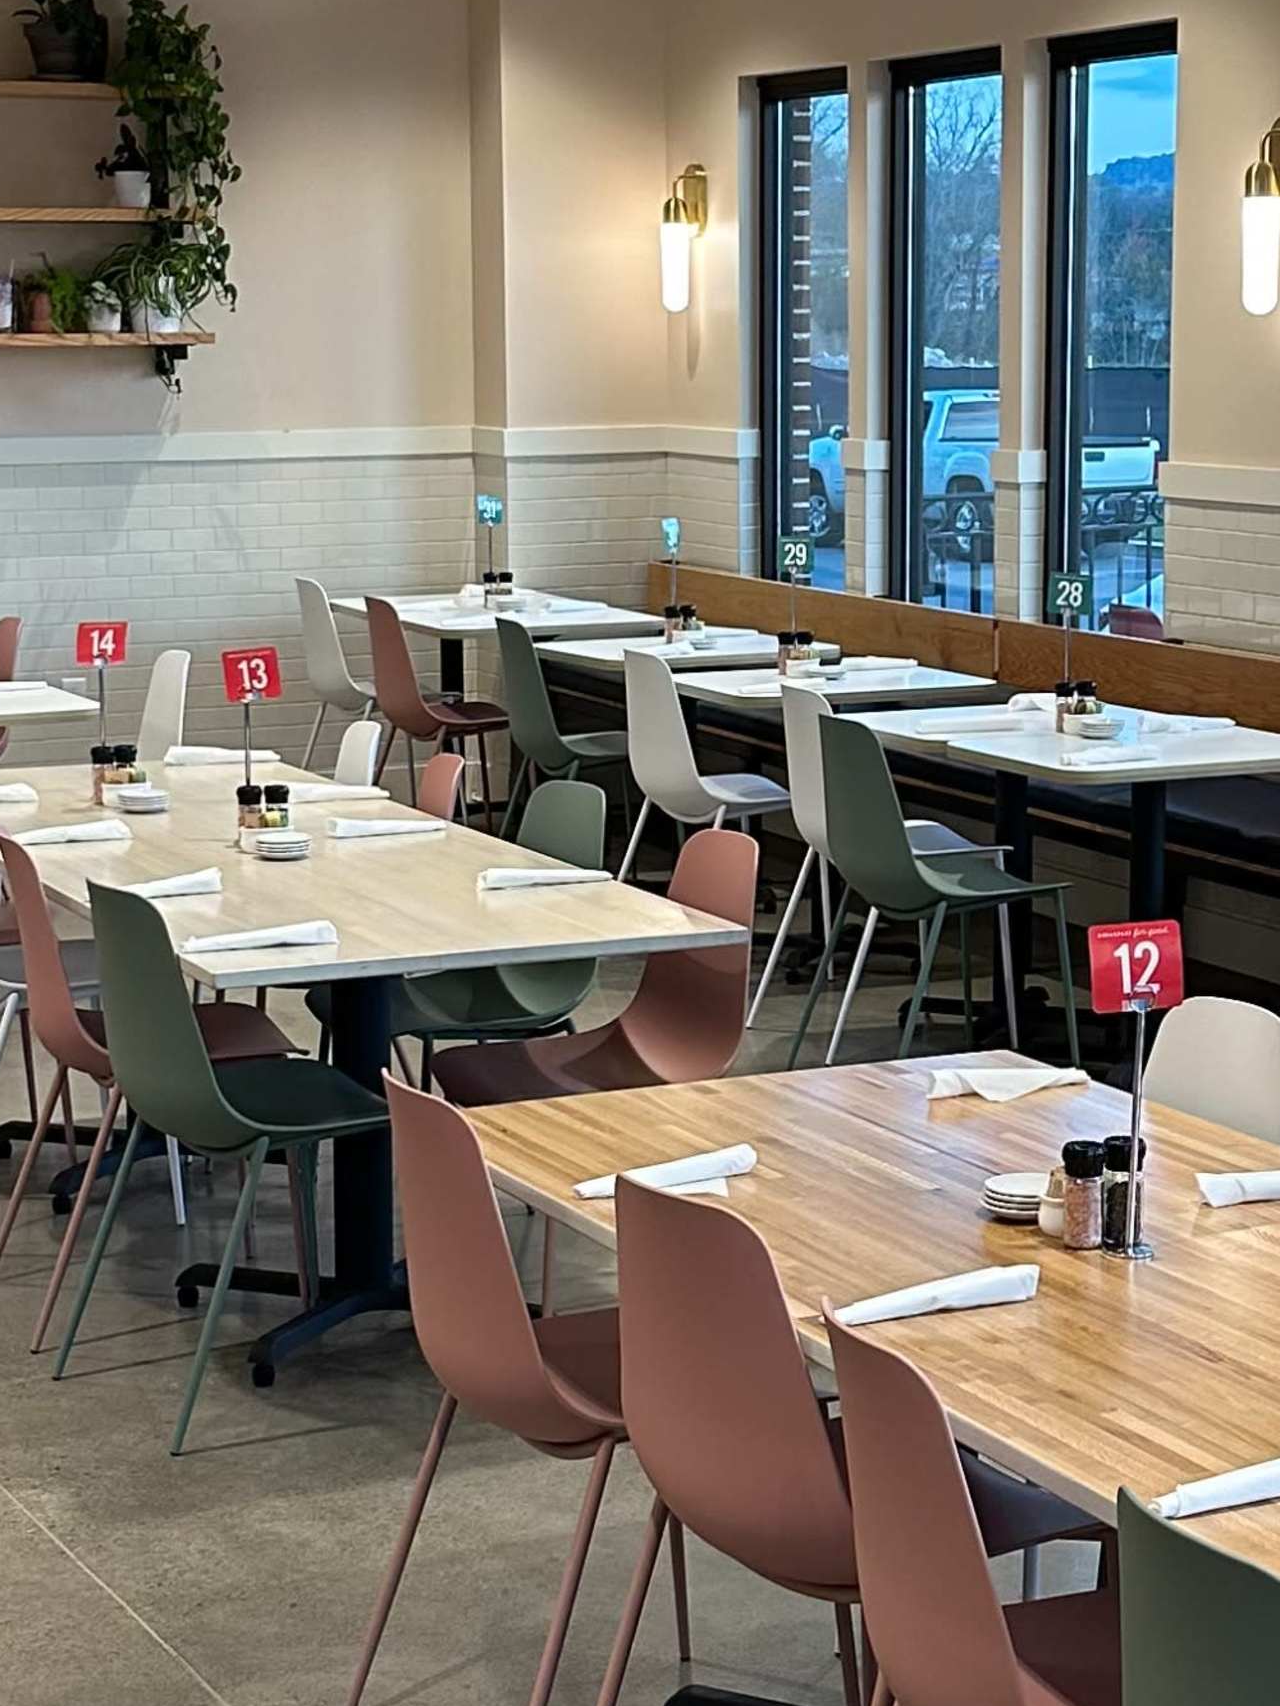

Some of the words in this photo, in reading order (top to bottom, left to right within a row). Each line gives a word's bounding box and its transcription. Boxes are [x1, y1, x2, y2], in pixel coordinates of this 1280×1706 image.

[784, 543, 807, 566] 29
[1056, 581, 1083, 607] 28
[90, 629, 116, 657] 14
[237, 658, 269, 691] 13
[1113, 940, 1161, 995] 12
